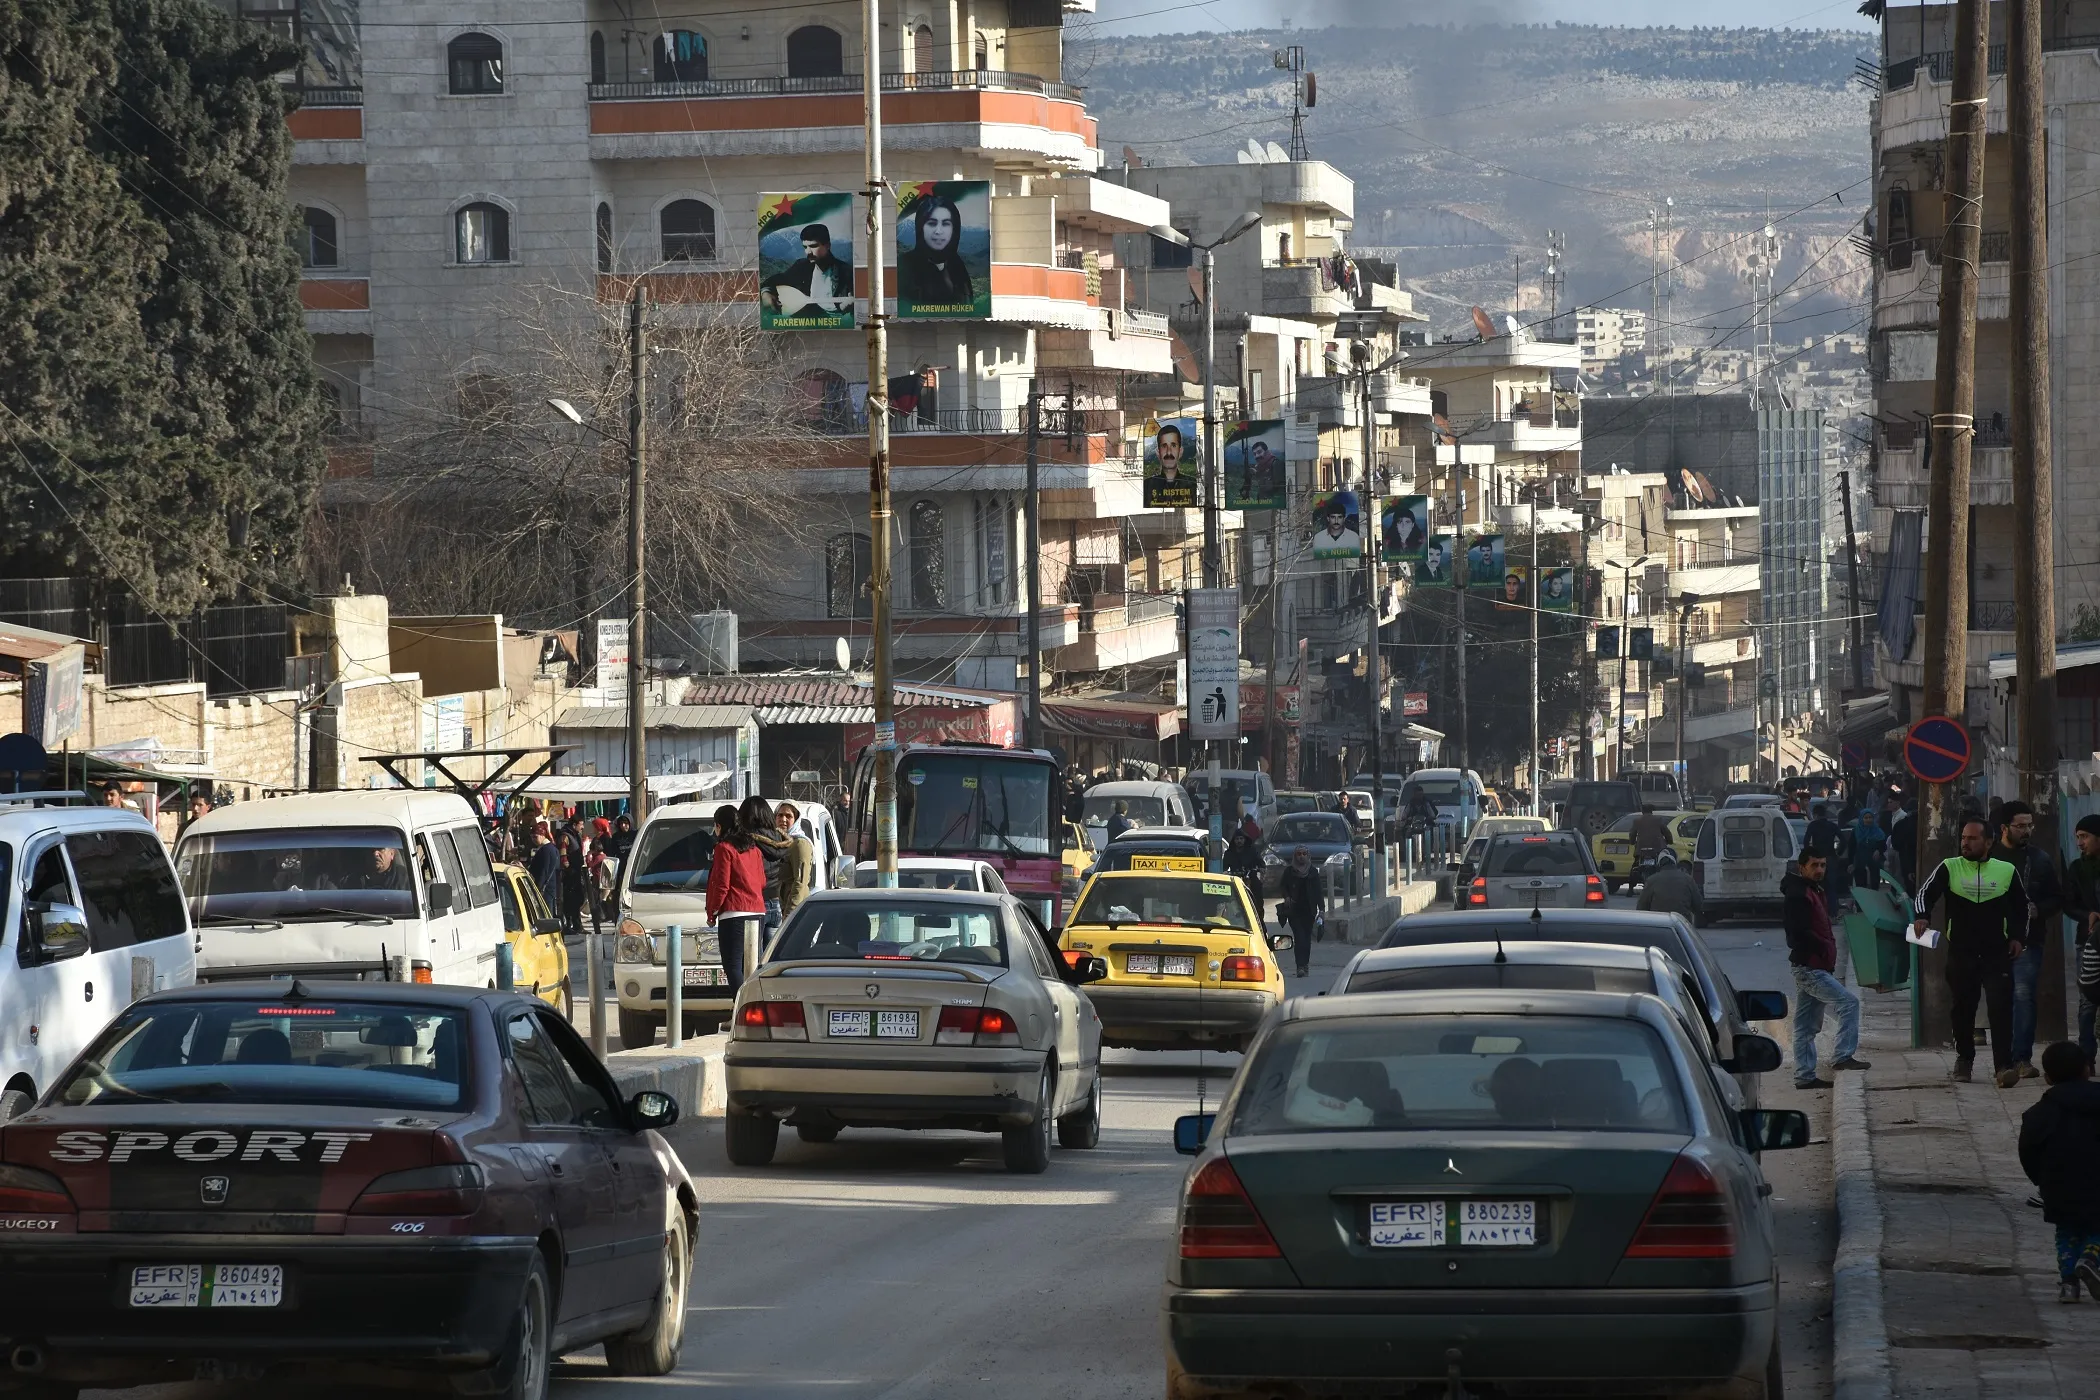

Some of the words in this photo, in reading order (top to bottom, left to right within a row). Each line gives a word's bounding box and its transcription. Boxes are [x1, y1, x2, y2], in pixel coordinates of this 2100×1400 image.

[898, 191, 916, 209] HPG
[757, 210, 775, 228] HPG
[911, 304, 950, 314] PAKREWAN
[951, 302, 974, 313] RÛKEN
[772, 317, 816, 328] PAKREWAN
[817, 316, 842, 329] NEŞET
[1163, 488, 1191, 496] RISTEM
[898, 717, 917, 730] So
[1136, 860, 1157, 869] TAXI
[1129, 954, 1151, 963] EFR
[1166, 956, 1194, 966] 971145
[831, 1012, 861, 1023] EFR
[881, 1012, 916, 1023] 861984
[830, 1026, 860, 1034] عفرين
[880, 1025, 916, 1036] ٨٦١٩٨٤
[48, 1130, 373, 1163] SPORT
[1372, 1204, 1426, 1223] EFR
[1467, 1203, 1533, 1221] 880239
[390, 1221, 425, 1233] 406
[1433, 1204, 1443, 1241] SYR
[1373, 1227, 1426, 1244] عفرين
[1467, 1226, 1534, 1241] ٨٨٠٢٣٩
[134, 1267, 184, 1284] EFR
[219, 1266, 280, 1284] 860492
[188, 1267, 199, 1303] SYR
[132, 1288, 181, 1305] عفرين
[217, 1288, 279, 1304] ٨٦٠٤٩٢
